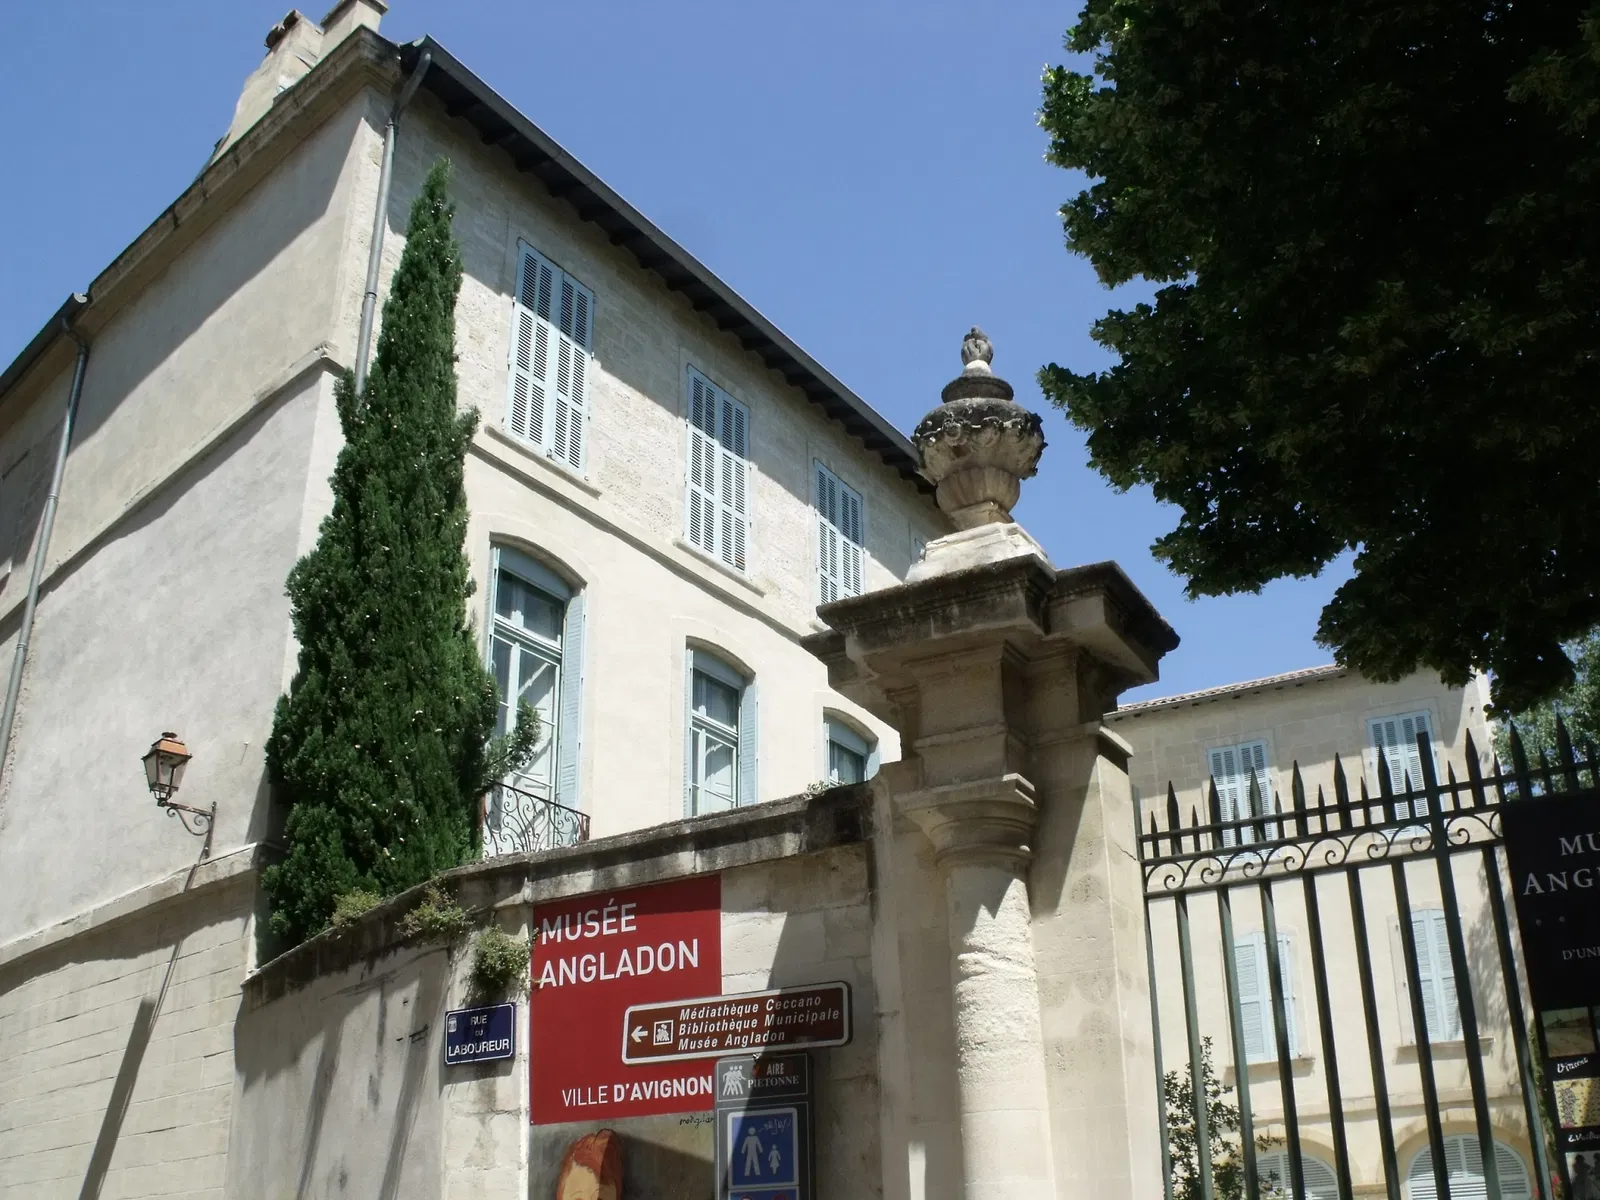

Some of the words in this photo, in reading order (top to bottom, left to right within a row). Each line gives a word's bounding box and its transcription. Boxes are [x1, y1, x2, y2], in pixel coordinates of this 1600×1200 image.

[1523, 867, 1600, 896] ANG
[541, 898, 637, 946] MUSÉE
[539, 938, 699, 989] ANGLADON
[470, 1014, 488, 1026] RUE
[679, 1002, 759, 1021] Médiathèque
[766, 995, 821, 1012] Ceccano
[678, 1018, 758, 1036] Bibliothèque
[764, 1009, 840, 1027] Municipale
[448, 1038, 510, 1057] LABOUREUR
[678, 1035, 718, 1051] Musée
[724, 1031, 785, 1049] Angladon
[766, 1062, 785, 1076] AIRE
[561, 1085, 608, 1107] VILLE
[613, 1075, 713, 1103] D'AVIGNON
